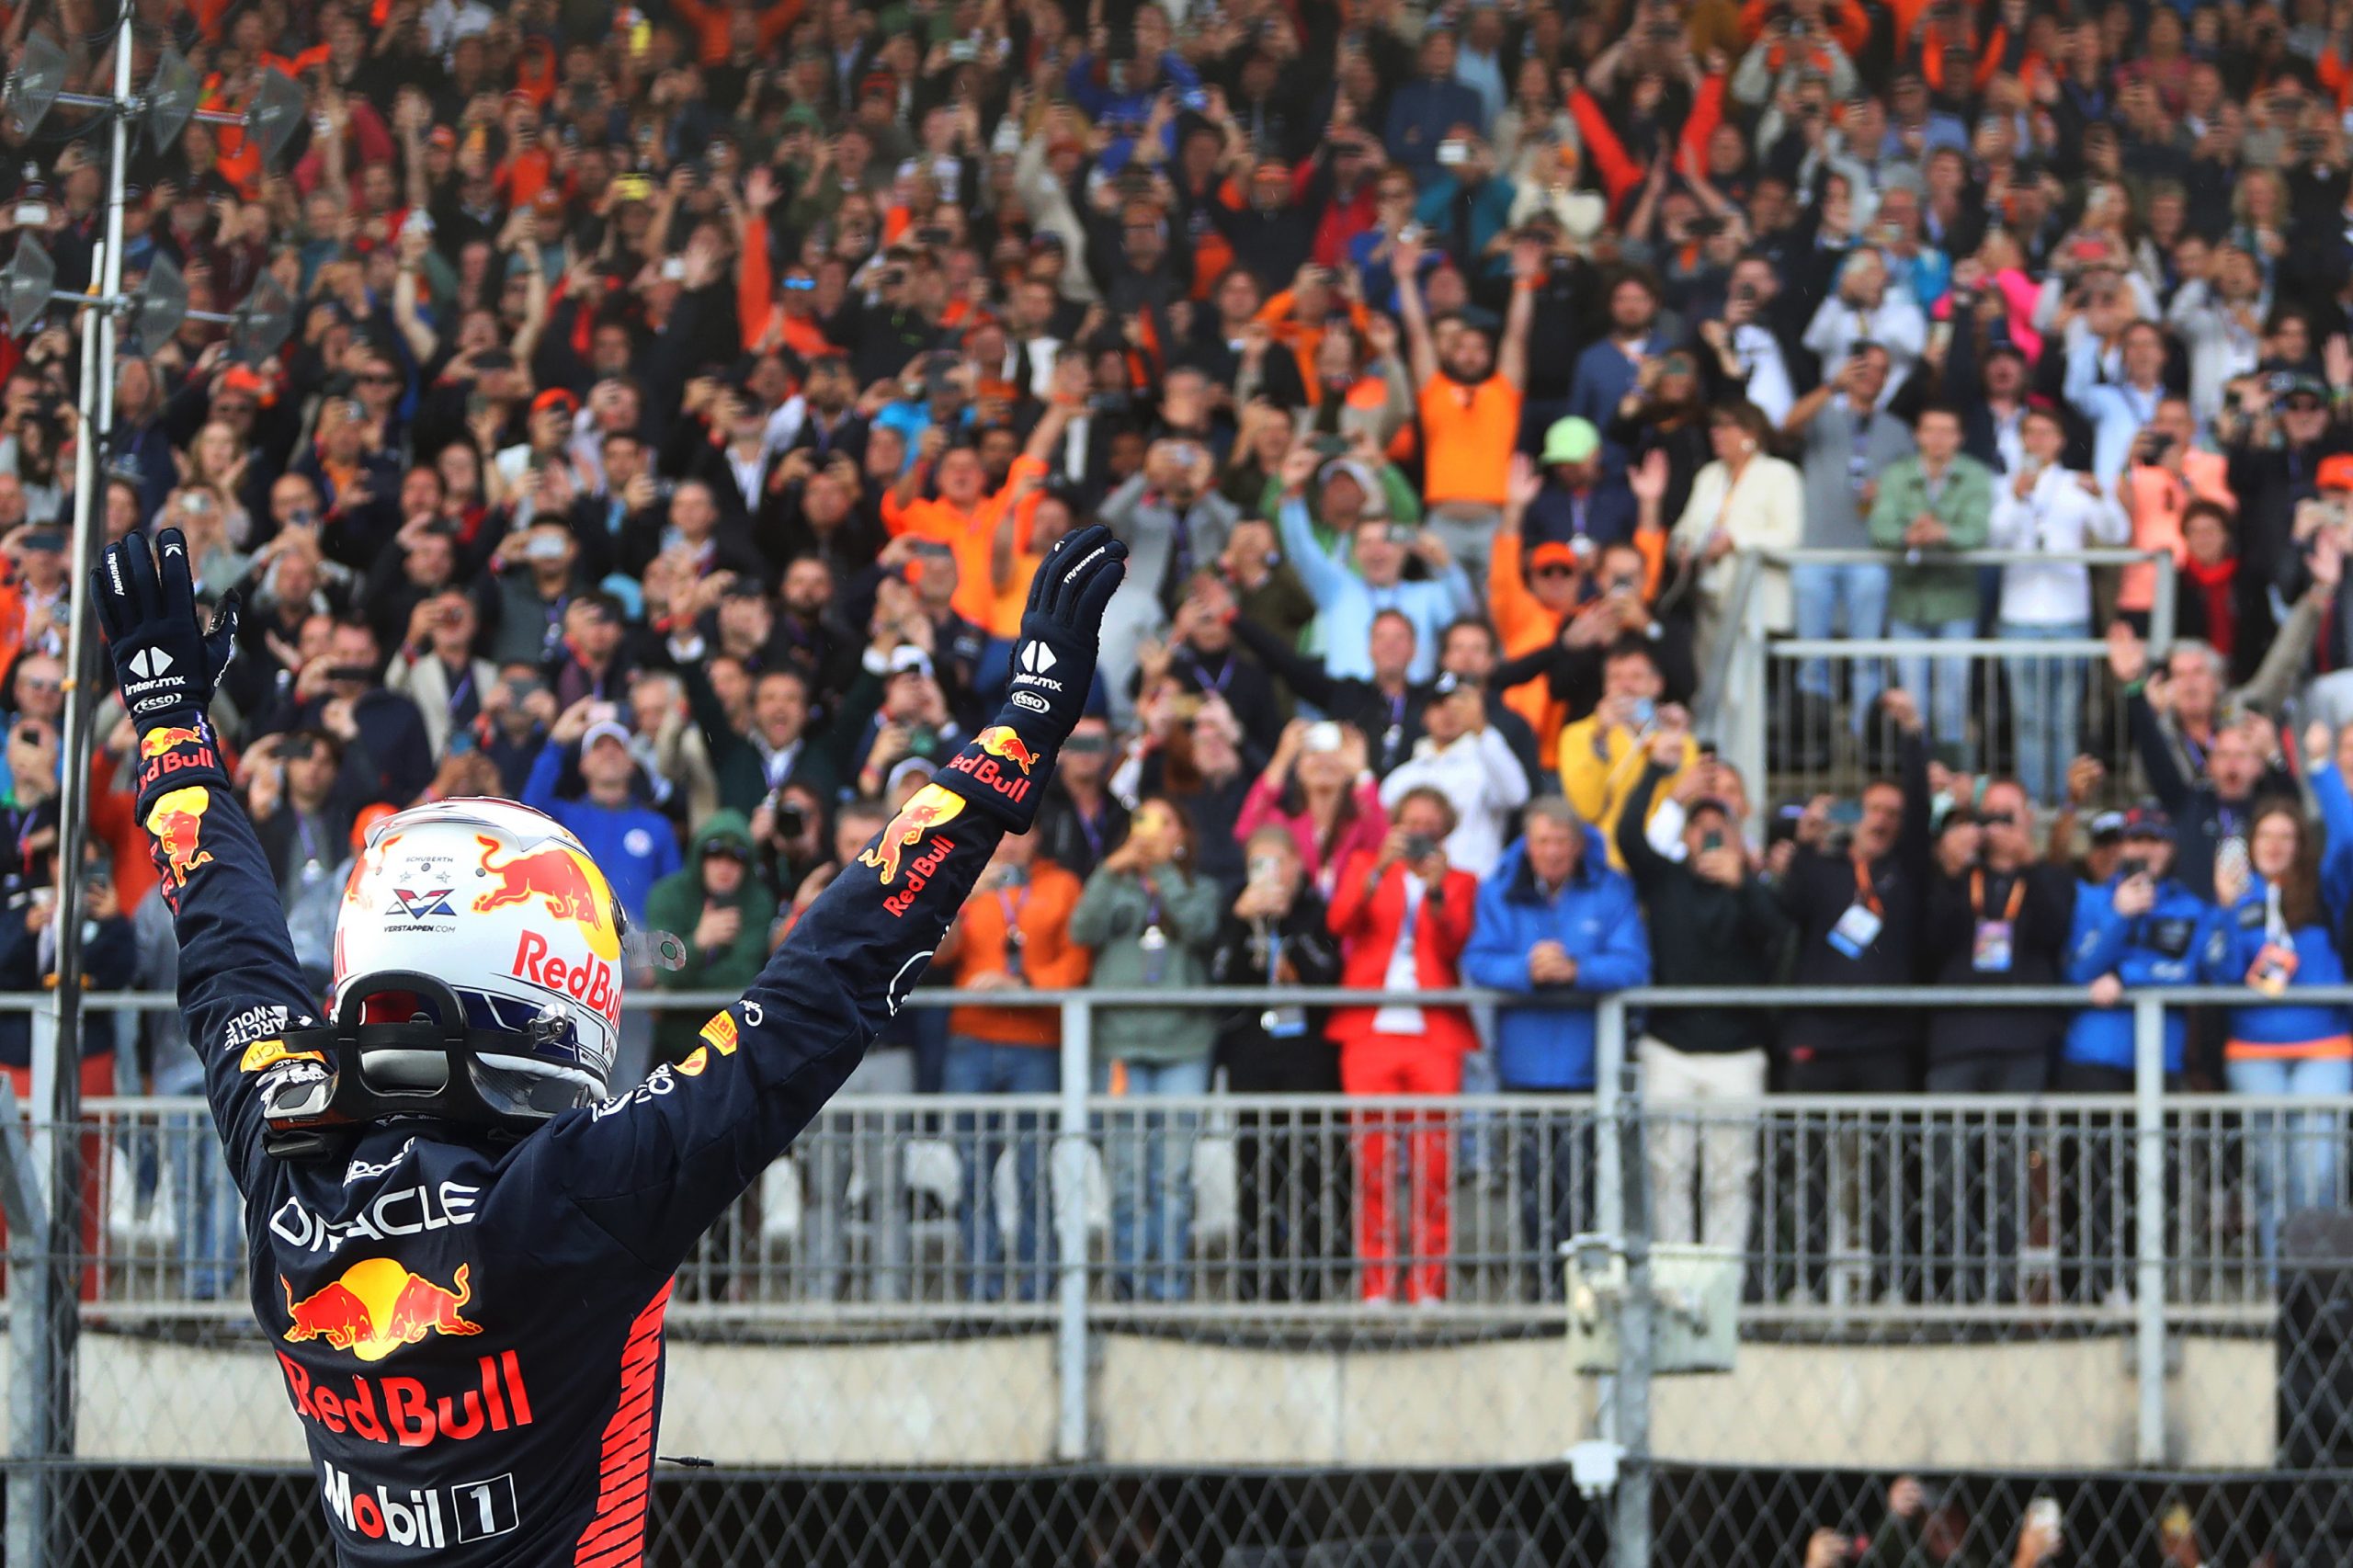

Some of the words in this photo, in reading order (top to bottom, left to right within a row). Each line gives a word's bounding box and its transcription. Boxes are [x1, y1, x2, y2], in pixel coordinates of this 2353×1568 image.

[124, 676, 186, 696] inter.mx
[162, 747, 215, 774] Bull
[947, 752, 985, 774] ed
[973, 758, 1031, 804] Bull
[882, 869, 926, 918] Red
[911, 835, 956, 878] Bull
[383, 925, 456, 934] VERSTAPPEN.COM
[512, 928, 594, 1000] Red
[224, 1017, 287, 1051] ARCTIC
[225, 1006, 275, 1039] WOLF
[276, 1349, 389, 1444] Red
[382, 1349, 533, 1447] Bull
[323, 1460, 446, 1549] Mobil
